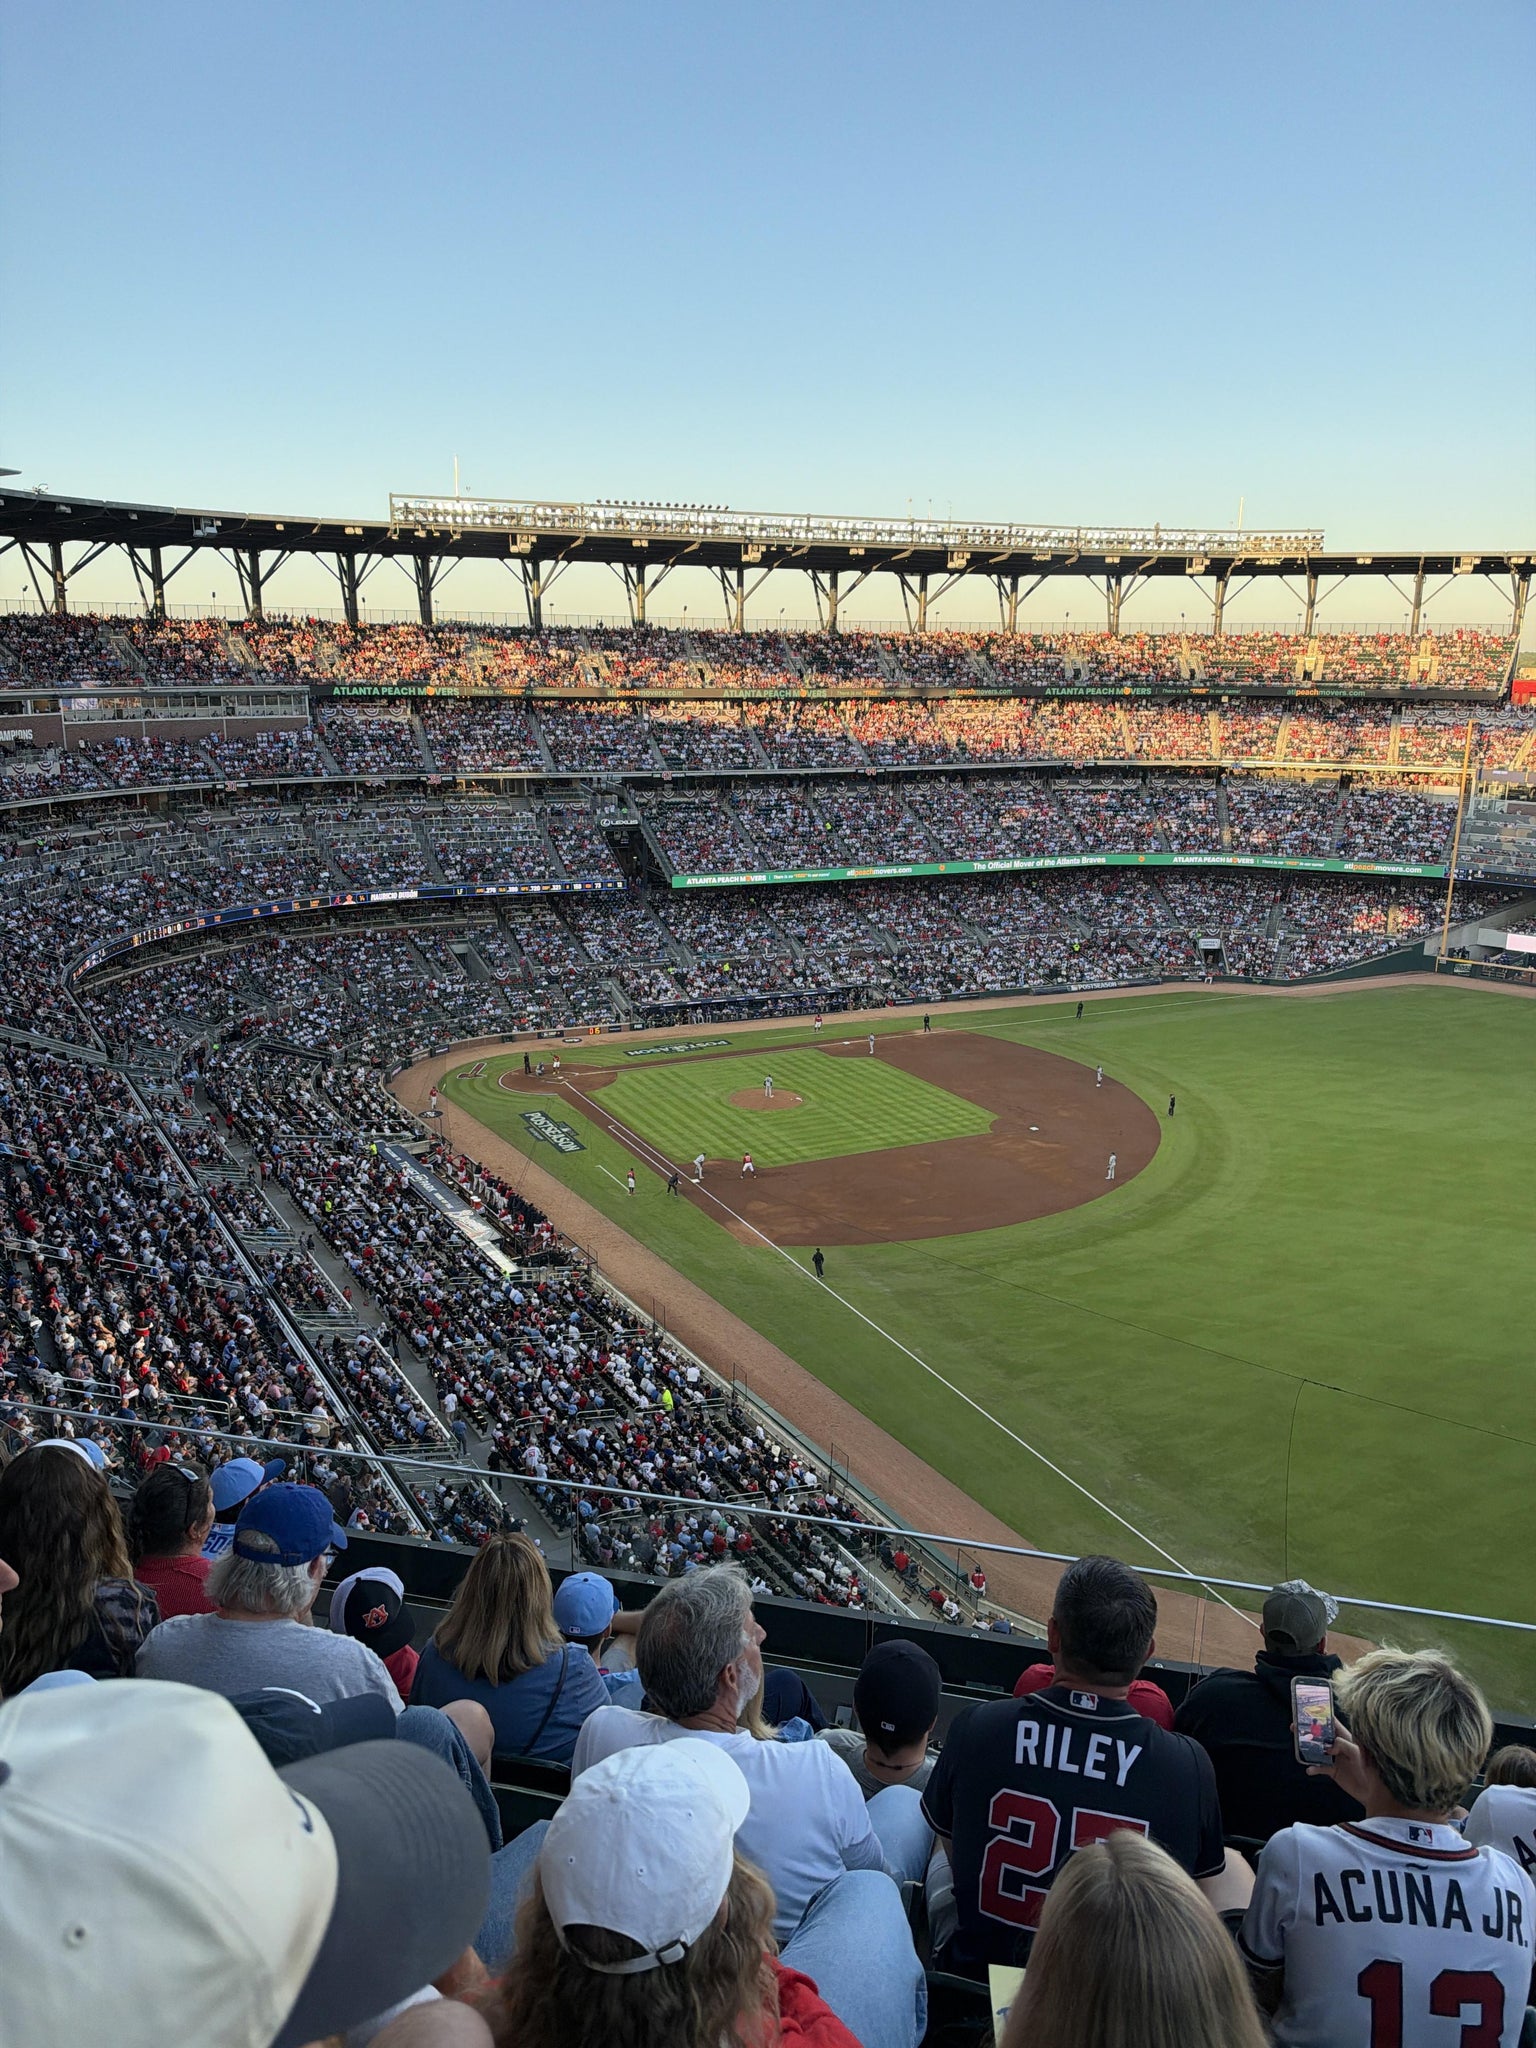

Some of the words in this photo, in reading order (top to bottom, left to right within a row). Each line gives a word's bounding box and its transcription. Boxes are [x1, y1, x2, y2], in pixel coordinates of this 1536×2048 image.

[333, 687, 379, 696] ATLANTA
[381, 687, 416, 696] PEACH
[723, 690, 762, 698] ATLANTA
[764, 690, 791, 698] PEACH
[1287, 688, 1365, 697] atlpeachmovers.com
[973, 862, 986, 870] The
[987, 861, 1012, 870] Official
[1013, 860, 1035, 868] Mover
[1036, 859, 1043, 867] of
[1081, 856, 1106, 864] Braves
[687, 877, 717, 885] ATLANTA
[1078, 981, 1117, 991] POSTSEASON
[524, 1112, 581, 1152] POSTSEASON
[1015, 1720, 1143, 1787] RILEY
[1314, 1863, 1473, 1933] ACUÑA
[1482, 1887, 1529, 1948] JR.
